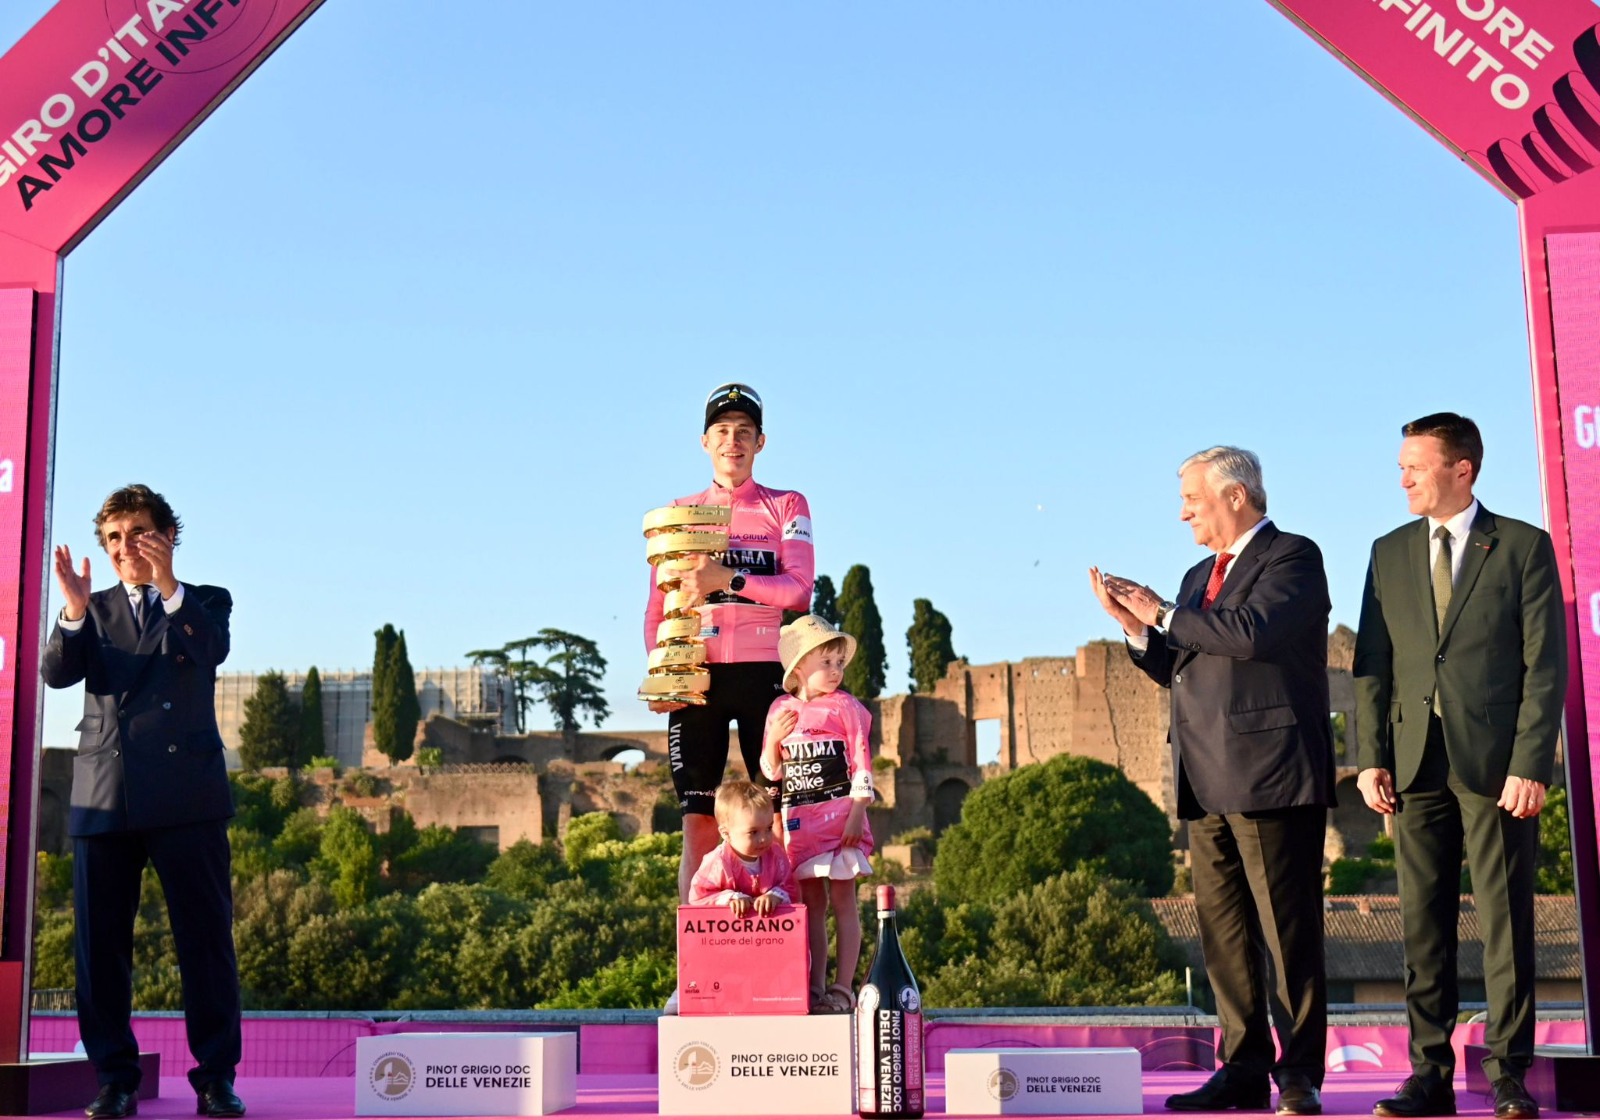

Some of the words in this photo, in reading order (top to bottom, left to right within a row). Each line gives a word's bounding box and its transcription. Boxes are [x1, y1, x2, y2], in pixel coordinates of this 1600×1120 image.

[1409, 0, 1555, 70] ORE
[70, 0, 191, 98] D'ITA
[17, 58, 164, 212] AMORE
[155, 0, 241, 66] INF
[743, 533, 769, 541] GIULIA
[670, 723, 684, 772] VISMA
[788, 740, 837, 759] VISMA
[785, 762, 822, 778] lease
[684, 918, 795, 933] ALTOGRANO
[708, 938, 736, 946] cuore
[738, 936, 753, 946] del
[755, 937, 785, 947] grano
[880, 1010, 891, 1052] DELLE
[892, 1010, 901, 1041] PINOT
[731, 1054, 763, 1063] PINOT
[767, 1053, 808, 1063] GRIGIO
[812, 1053, 838, 1062] DOC
[892, 1045, 902, 1084] GRIGIO
[426, 1065, 457, 1075] PINOT
[461, 1065, 502, 1075] GRIGIO
[505, 1065, 531, 1075] DOC
[731, 1066, 774, 1077] DELLE
[780, 1065, 839, 1076] VENEZIE
[426, 1077, 468, 1088] DELLE
[473, 1077, 531, 1088] VENEZIE
[880, 1056, 892, 1113] VENEZIE
[1026, 1085, 1057, 1093] DELLE
[1060, 1085, 1102, 1093] VENEZIE
[893, 1087, 902, 1112] DOC
